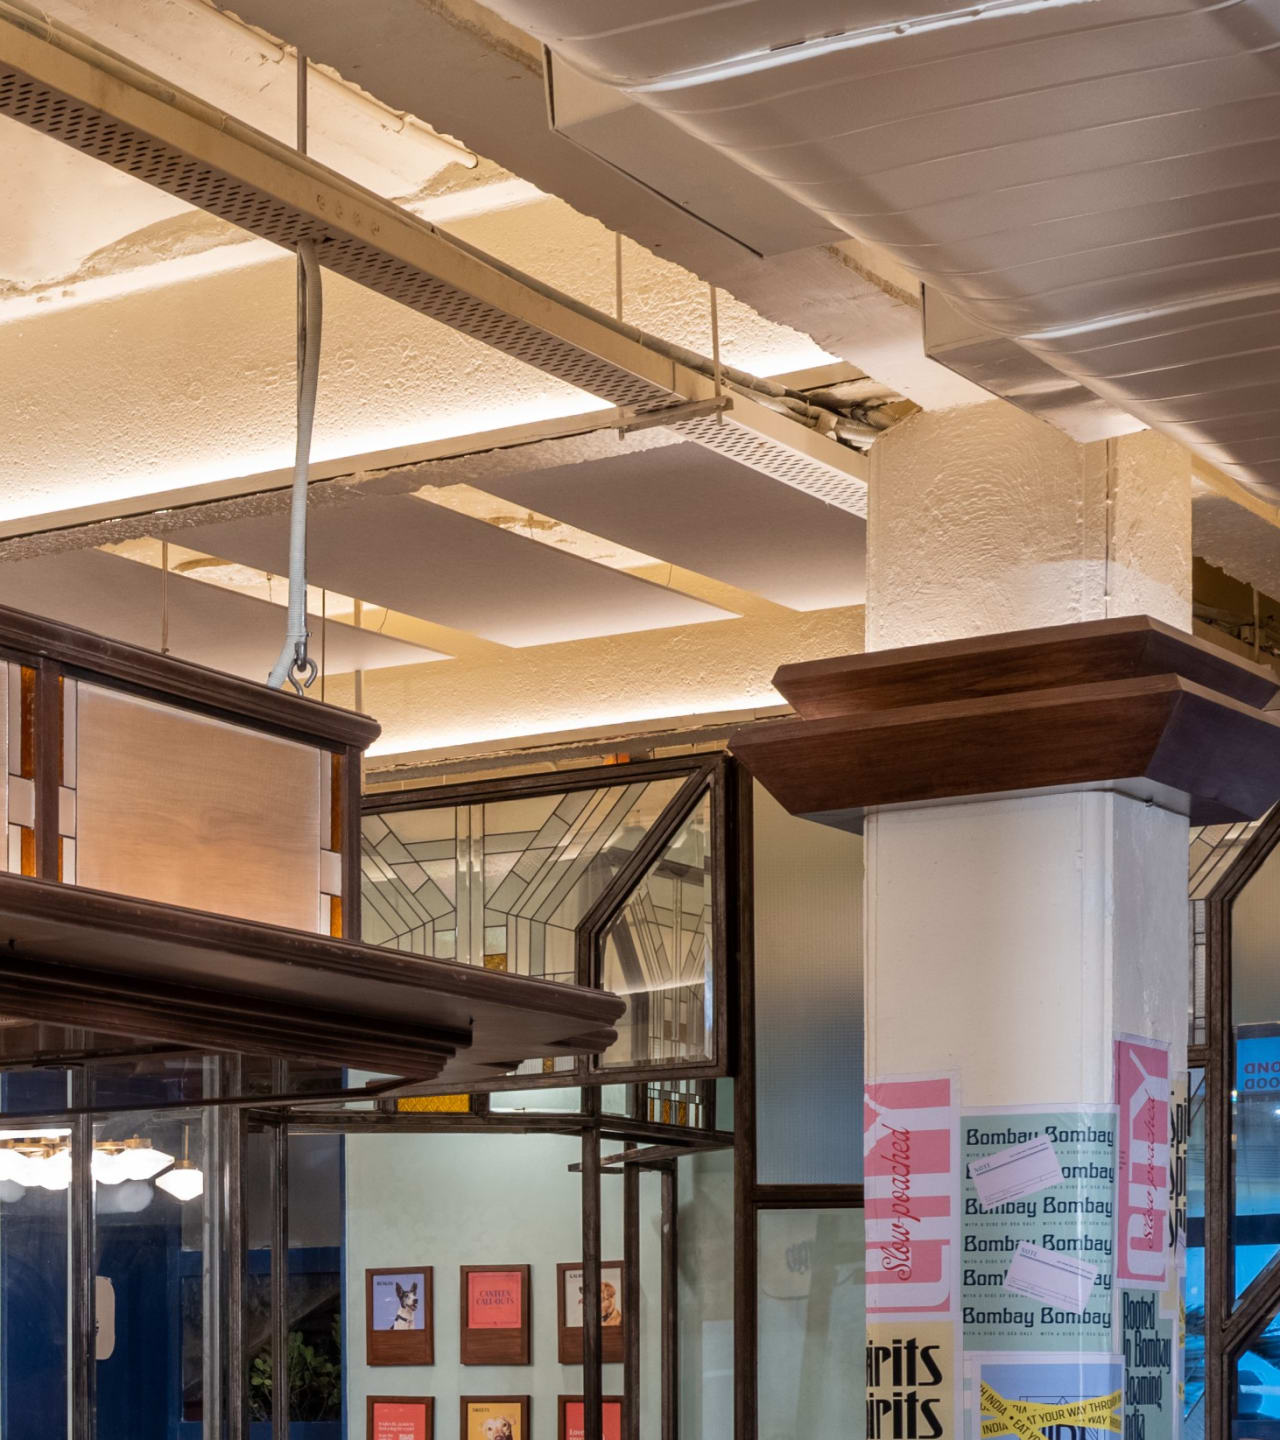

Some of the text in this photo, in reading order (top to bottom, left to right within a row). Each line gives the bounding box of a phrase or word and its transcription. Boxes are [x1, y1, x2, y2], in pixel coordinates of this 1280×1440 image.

[1045, 1126, 1114, 1147] Bombay
[1062, 1162, 1114, 1183] ombay
[1043, 1197, 1112, 1218] Bombay
[964, 1234, 1112, 1255] Bomb Bombay
[963, 1307, 1111, 1328] Bombay Bombay
[1123, 1291, 1155, 1330] Rooted
[866, 1337, 943, 1387] irits
[1134, 1331, 1171, 1374] Bombay
[866, 1391, 943, 1439] irits
[1038, 1409, 1066, 1424] YOUR
[1068, 1404, 1088, 1419] WAY
[1012, 1418, 1029, 1434] EAT
